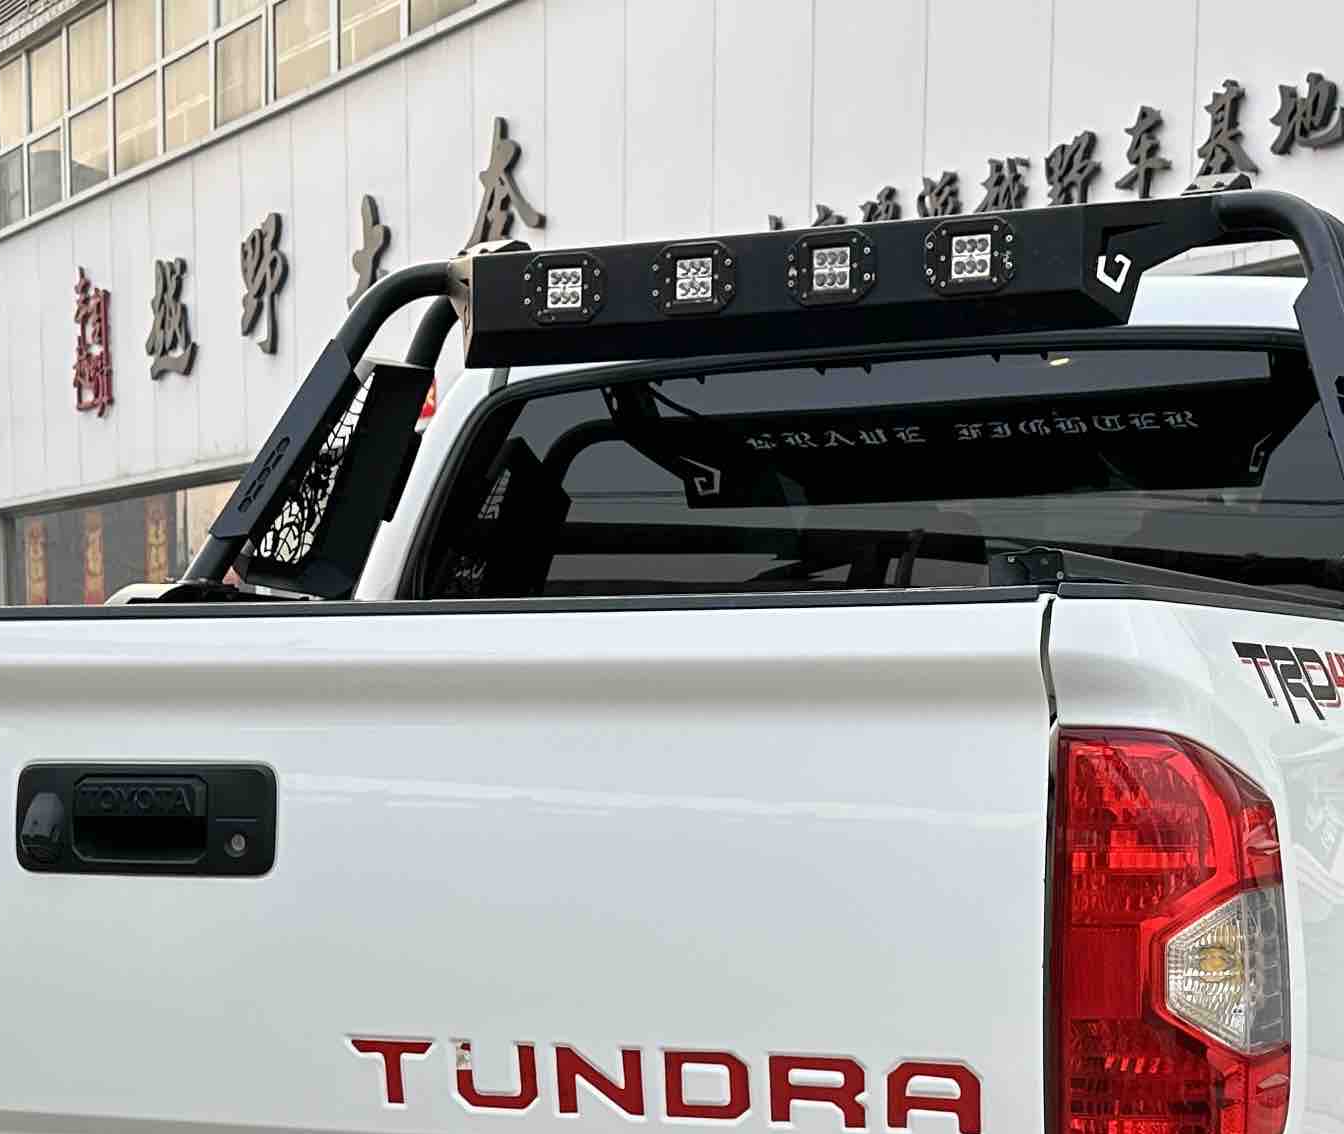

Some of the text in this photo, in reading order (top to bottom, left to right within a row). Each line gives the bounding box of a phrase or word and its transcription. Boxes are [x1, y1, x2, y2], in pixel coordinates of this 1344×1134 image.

[955, 409, 1200, 442] FIGHTER
[1232, 641, 1338, 724] TRD
[80, 786, 192, 812] TOYOTA
